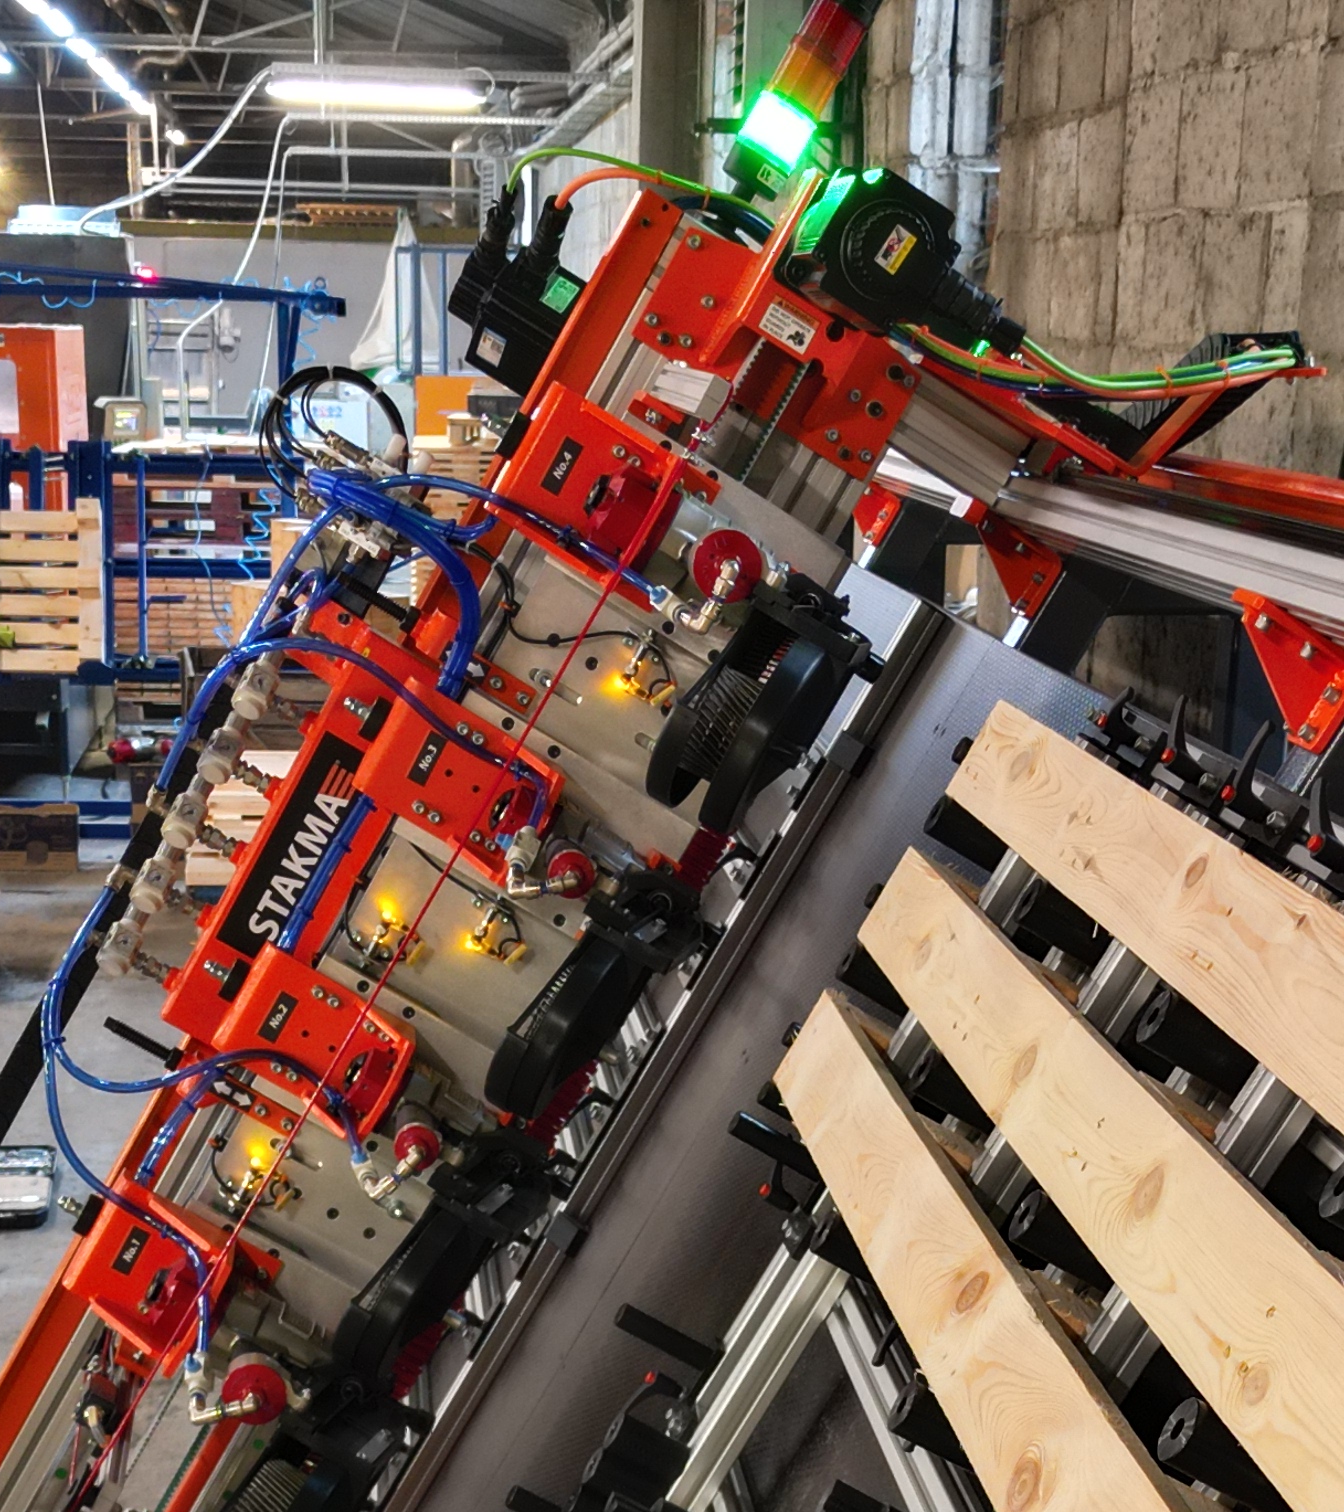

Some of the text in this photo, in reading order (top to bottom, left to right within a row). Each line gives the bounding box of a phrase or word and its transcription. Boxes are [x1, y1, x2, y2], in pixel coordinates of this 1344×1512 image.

[553, 451, 572, 479] No.4
[419, 745, 437, 771] No.3
[248, 793, 349, 942] STAKMA
[269, 1004, 288, 1028] No.2
[123, 1239, 140, 1262] No.1
